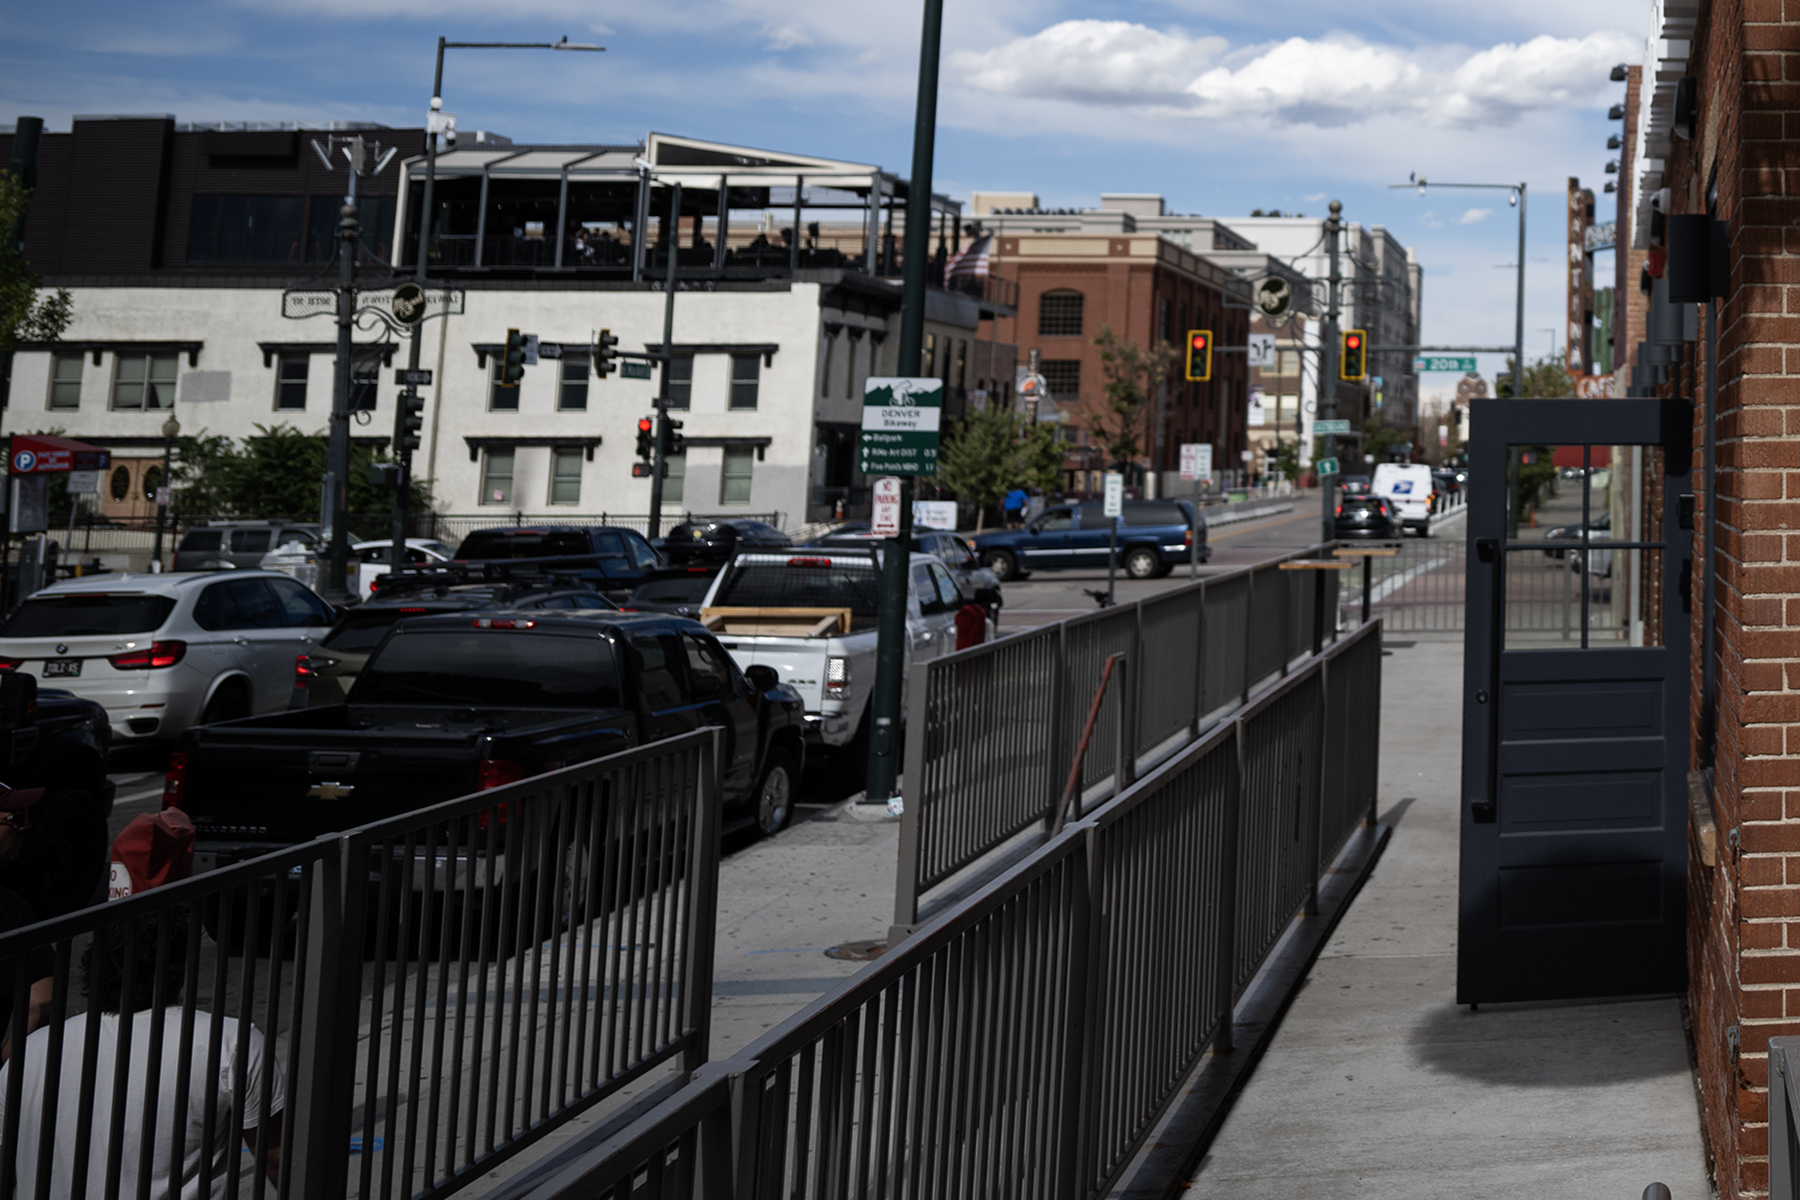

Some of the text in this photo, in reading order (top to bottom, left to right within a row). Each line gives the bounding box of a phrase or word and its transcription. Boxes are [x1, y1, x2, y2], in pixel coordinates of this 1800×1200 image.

[1569, 191, 1584, 371] CANTINA
[1430, 358, 1459, 370] 20th
[881, 409, 920, 418] DENVER
[883, 418, 918, 428] Bikeway
[873, 433, 902, 444] Ballpark
[882, 480, 892, 491] NO
